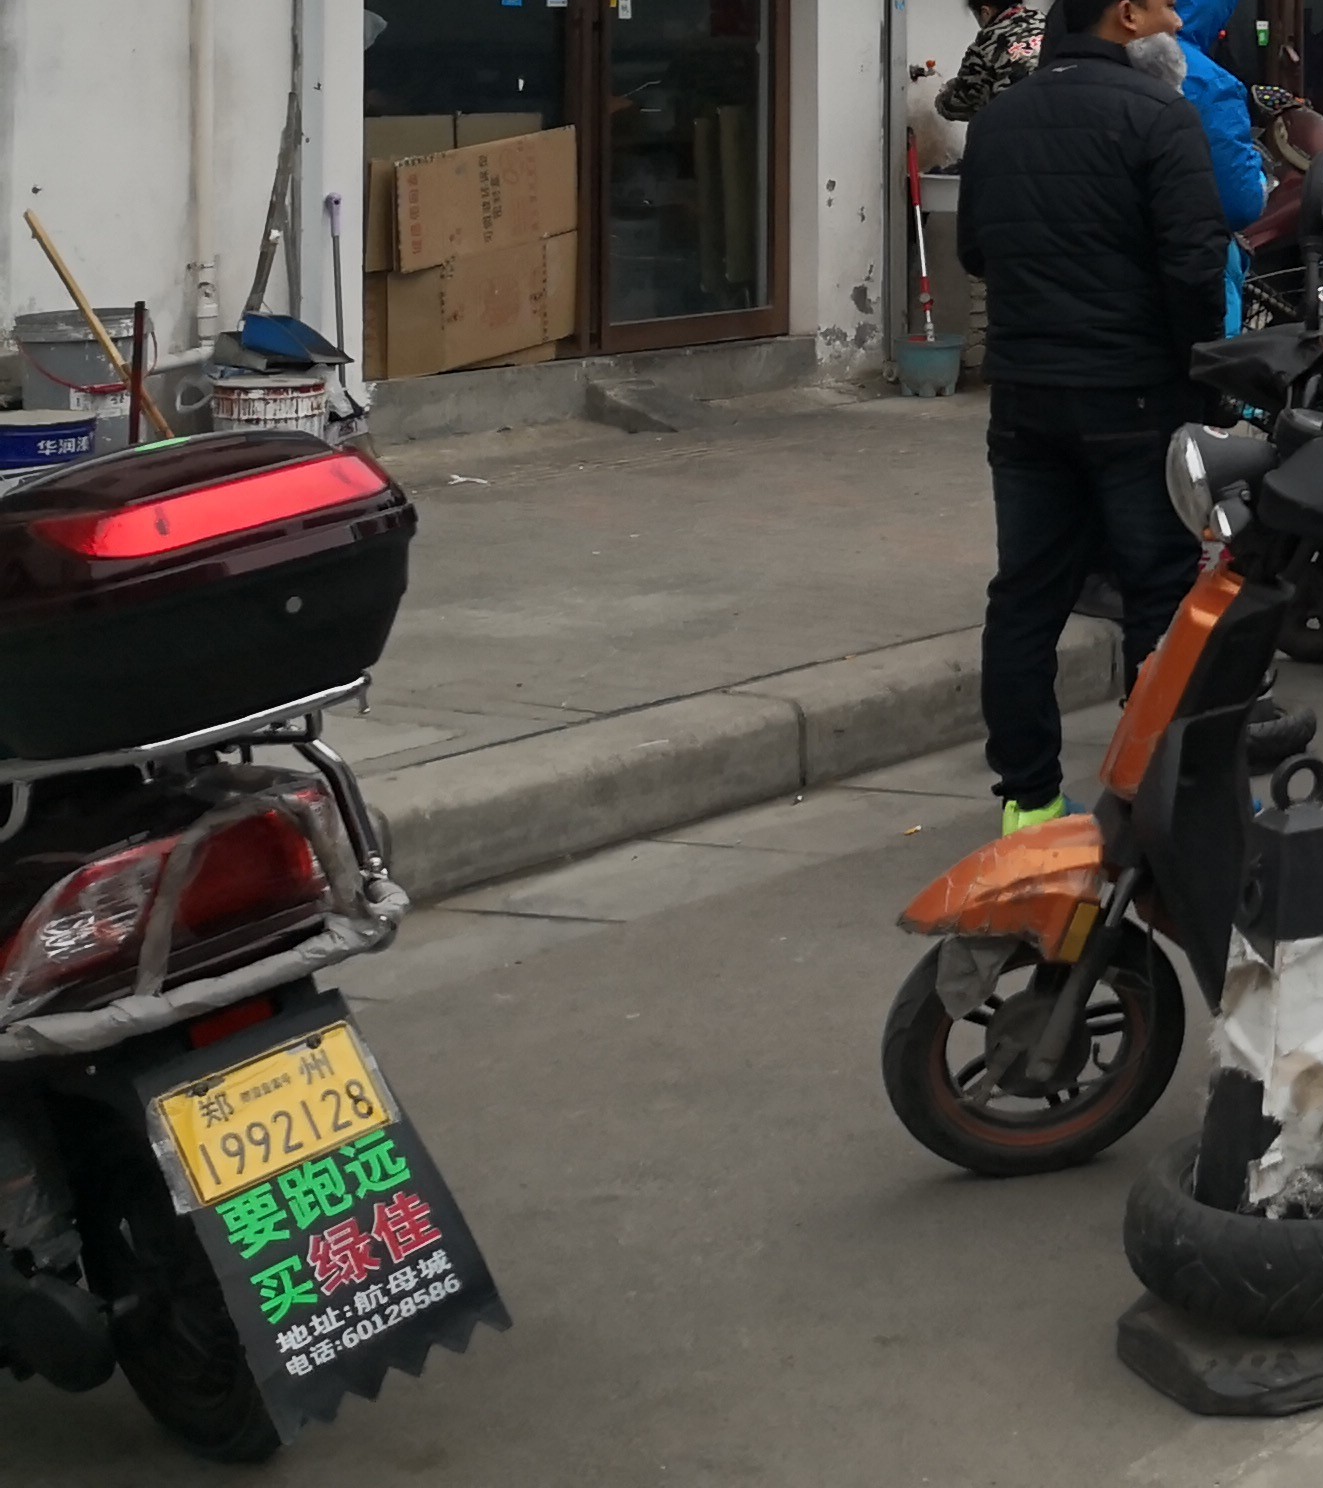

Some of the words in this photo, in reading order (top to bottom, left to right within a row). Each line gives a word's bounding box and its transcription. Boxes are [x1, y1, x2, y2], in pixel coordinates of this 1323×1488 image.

[297, 1048, 336, 1085] 州
[198, 1078, 375, 1187] 1992128
[215, 1129, 412, 1260] 要跑远
[250, 1191, 443, 1325] 买绿佳
[285, 1273, 462, 1377] 电话:60128586
